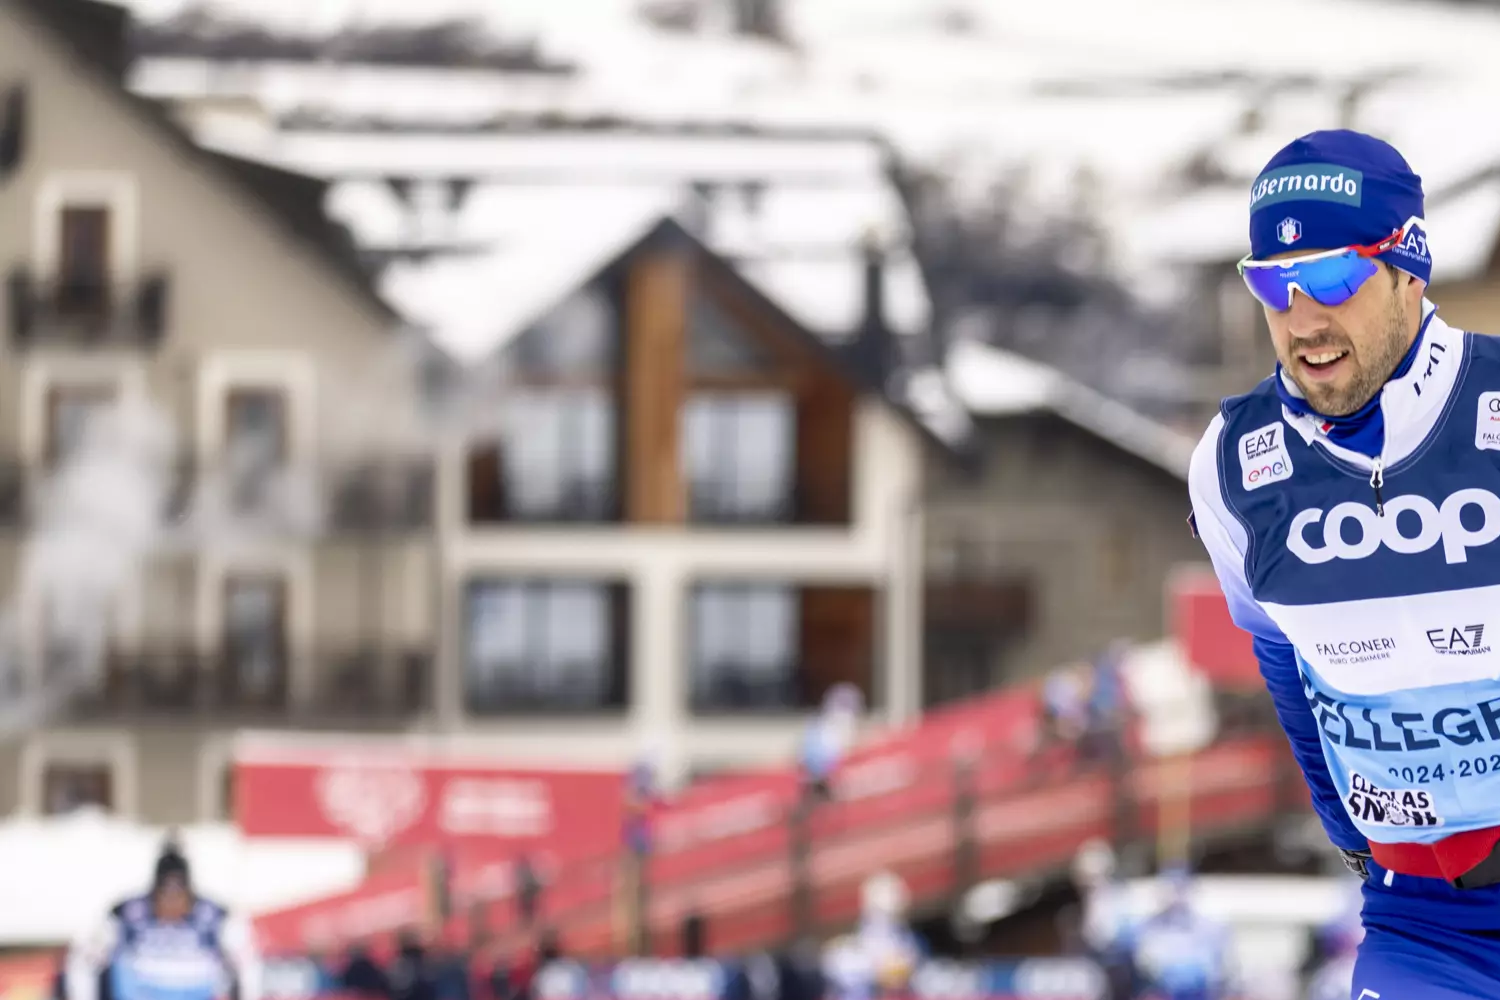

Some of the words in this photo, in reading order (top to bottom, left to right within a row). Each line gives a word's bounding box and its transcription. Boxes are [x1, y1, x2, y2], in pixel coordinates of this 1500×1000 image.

[1245, 429, 1277, 455] EA7
[1248, 454, 1288, 483] enel
[1315, 637, 1396, 656] FALCONERI
[1426, 624, 1485, 650] EA7
[1350, 652, 1391, 664] CASHMERE
[1402, 791, 1430, 810] AS
